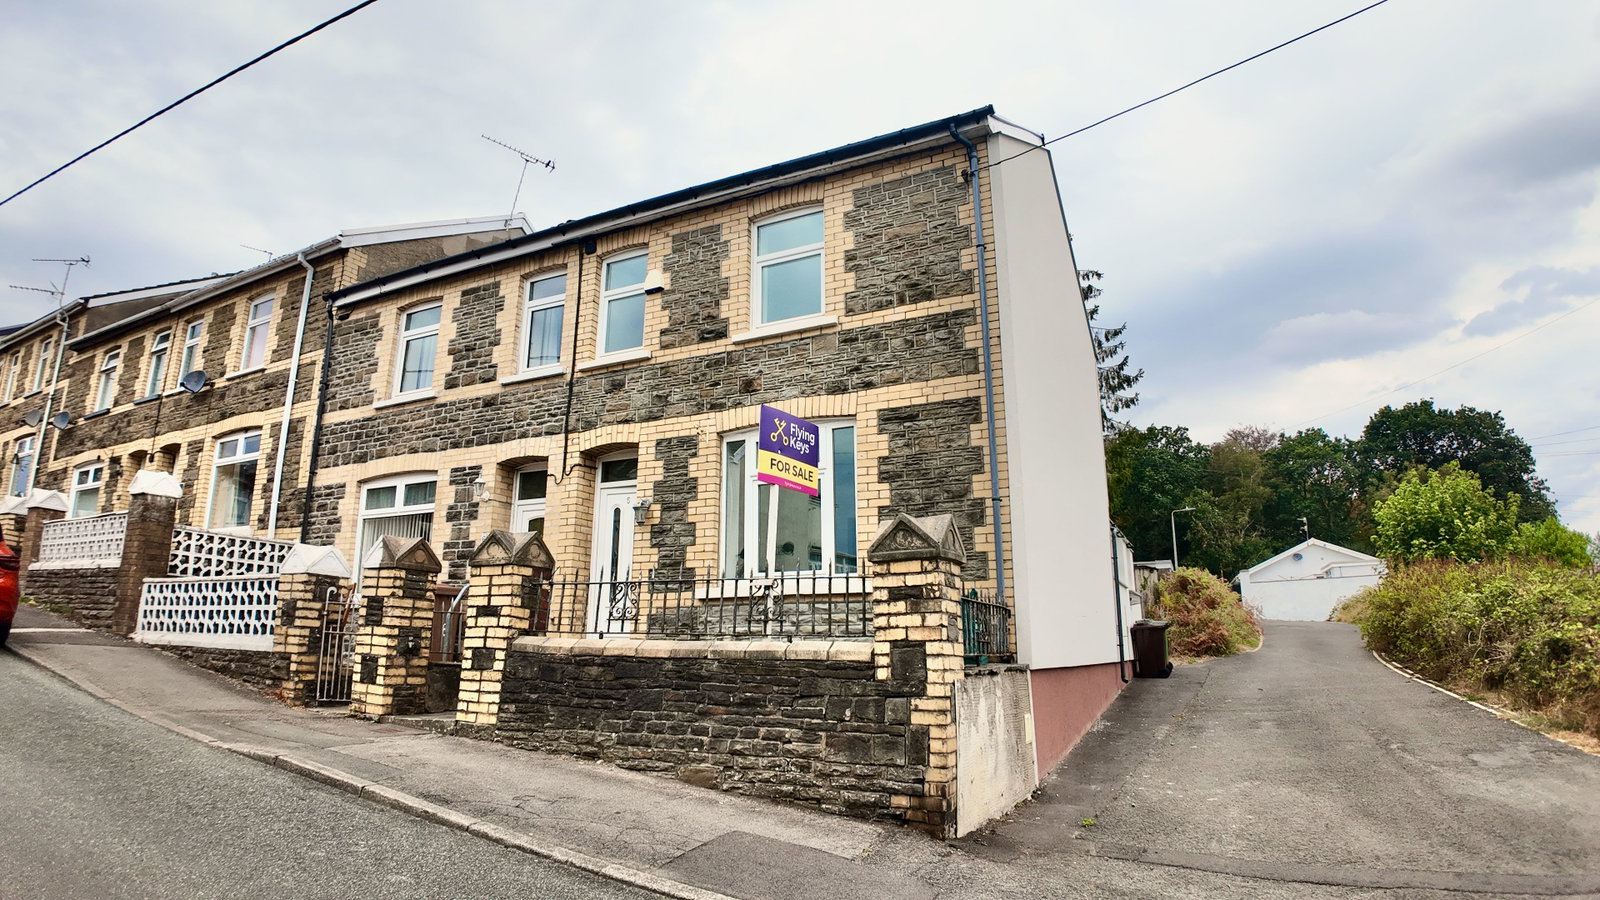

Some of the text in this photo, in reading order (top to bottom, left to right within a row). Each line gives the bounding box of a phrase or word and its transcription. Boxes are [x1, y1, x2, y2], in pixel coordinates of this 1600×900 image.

[789, 436, 810, 454] Keys
[790, 422, 815, 446] Flying
[770, 458, 813, 482] FOR SALE
